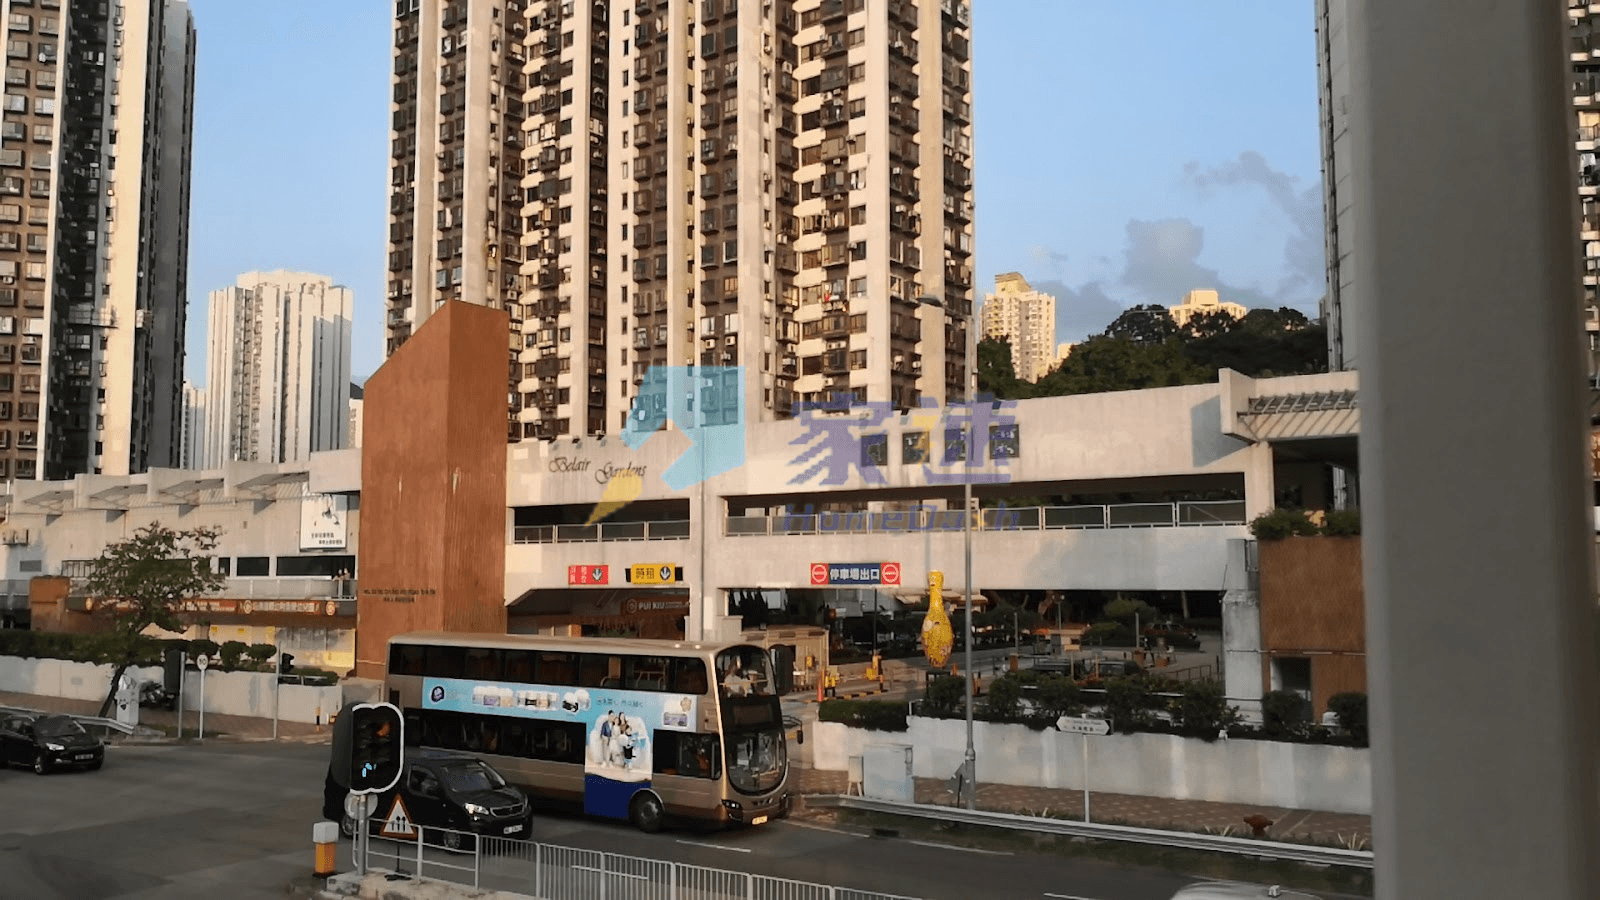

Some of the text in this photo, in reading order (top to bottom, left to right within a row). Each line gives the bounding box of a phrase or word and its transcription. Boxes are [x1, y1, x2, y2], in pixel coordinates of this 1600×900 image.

[548, 456, 647, 485] Belair Gardens
[829, 567, 880, 581] 停車場出口
